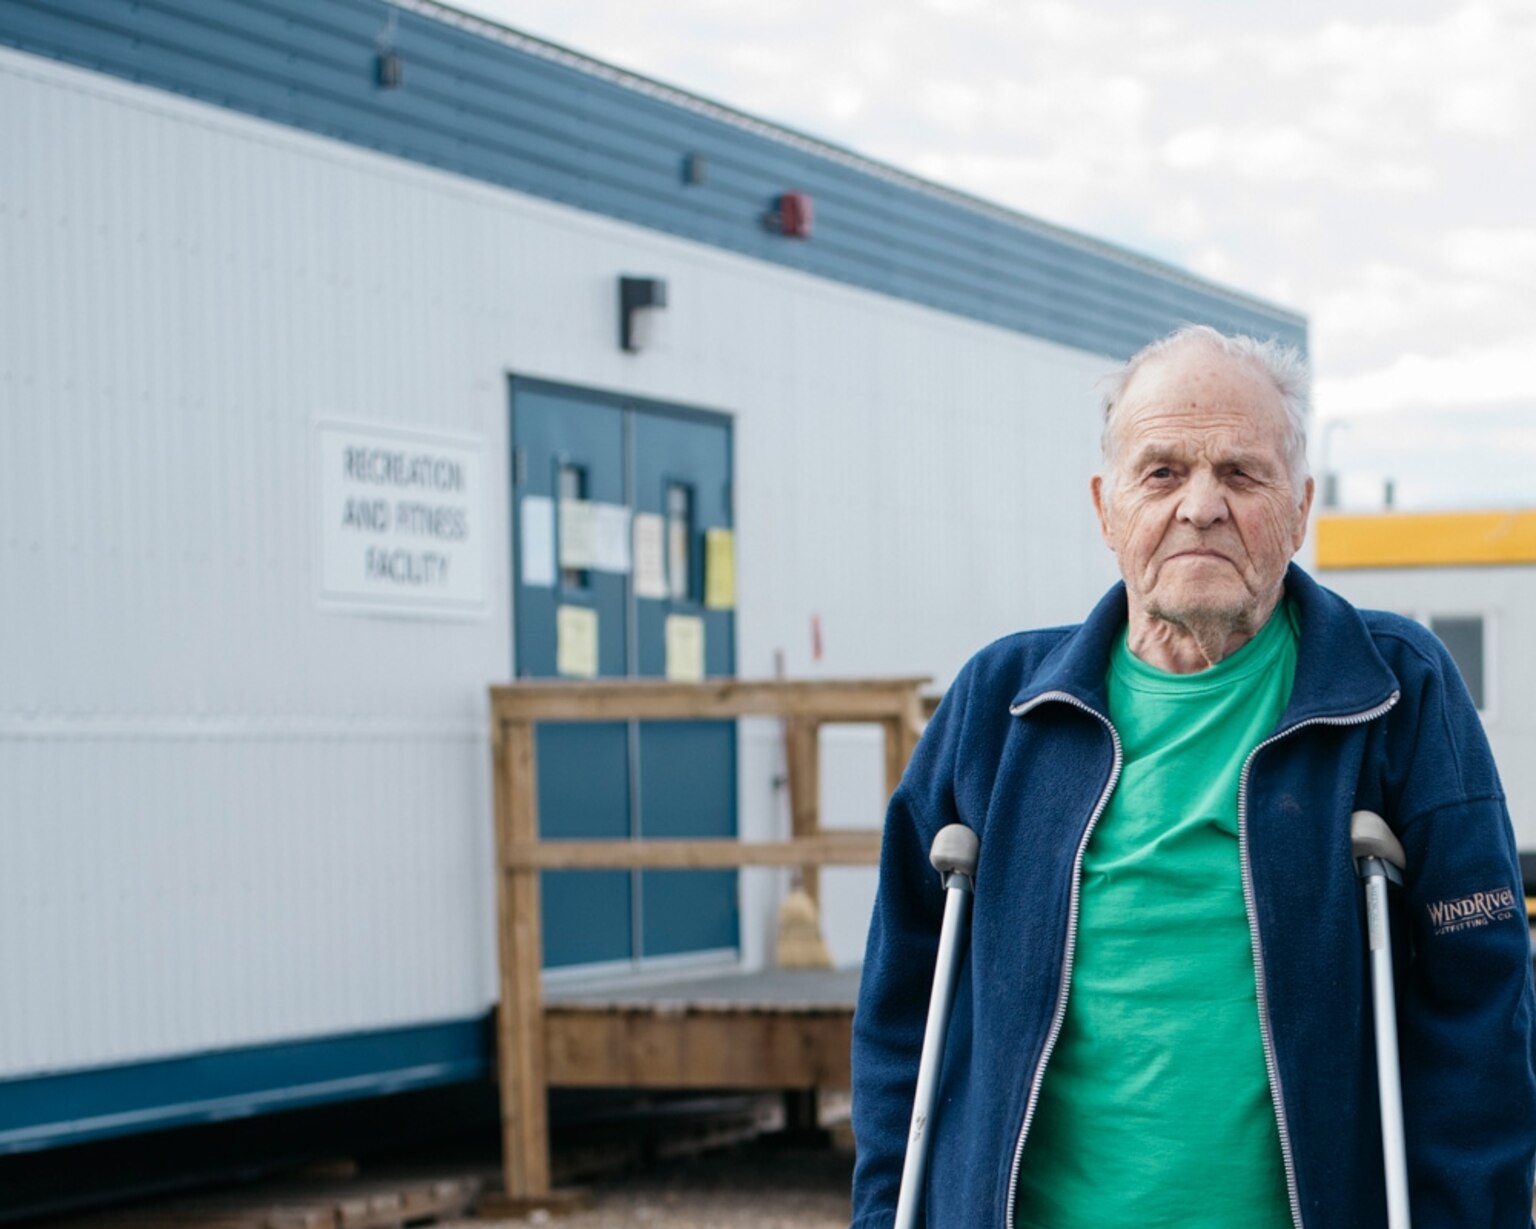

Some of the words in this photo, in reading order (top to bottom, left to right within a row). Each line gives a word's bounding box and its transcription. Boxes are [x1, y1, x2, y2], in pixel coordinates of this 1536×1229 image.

[343, 447, 465, 492] RECREATION
[341, 496, 390, 532] AND
[396, 499, 469, 541] FITNESS
[365, 546, 448, 586] FACILITY
